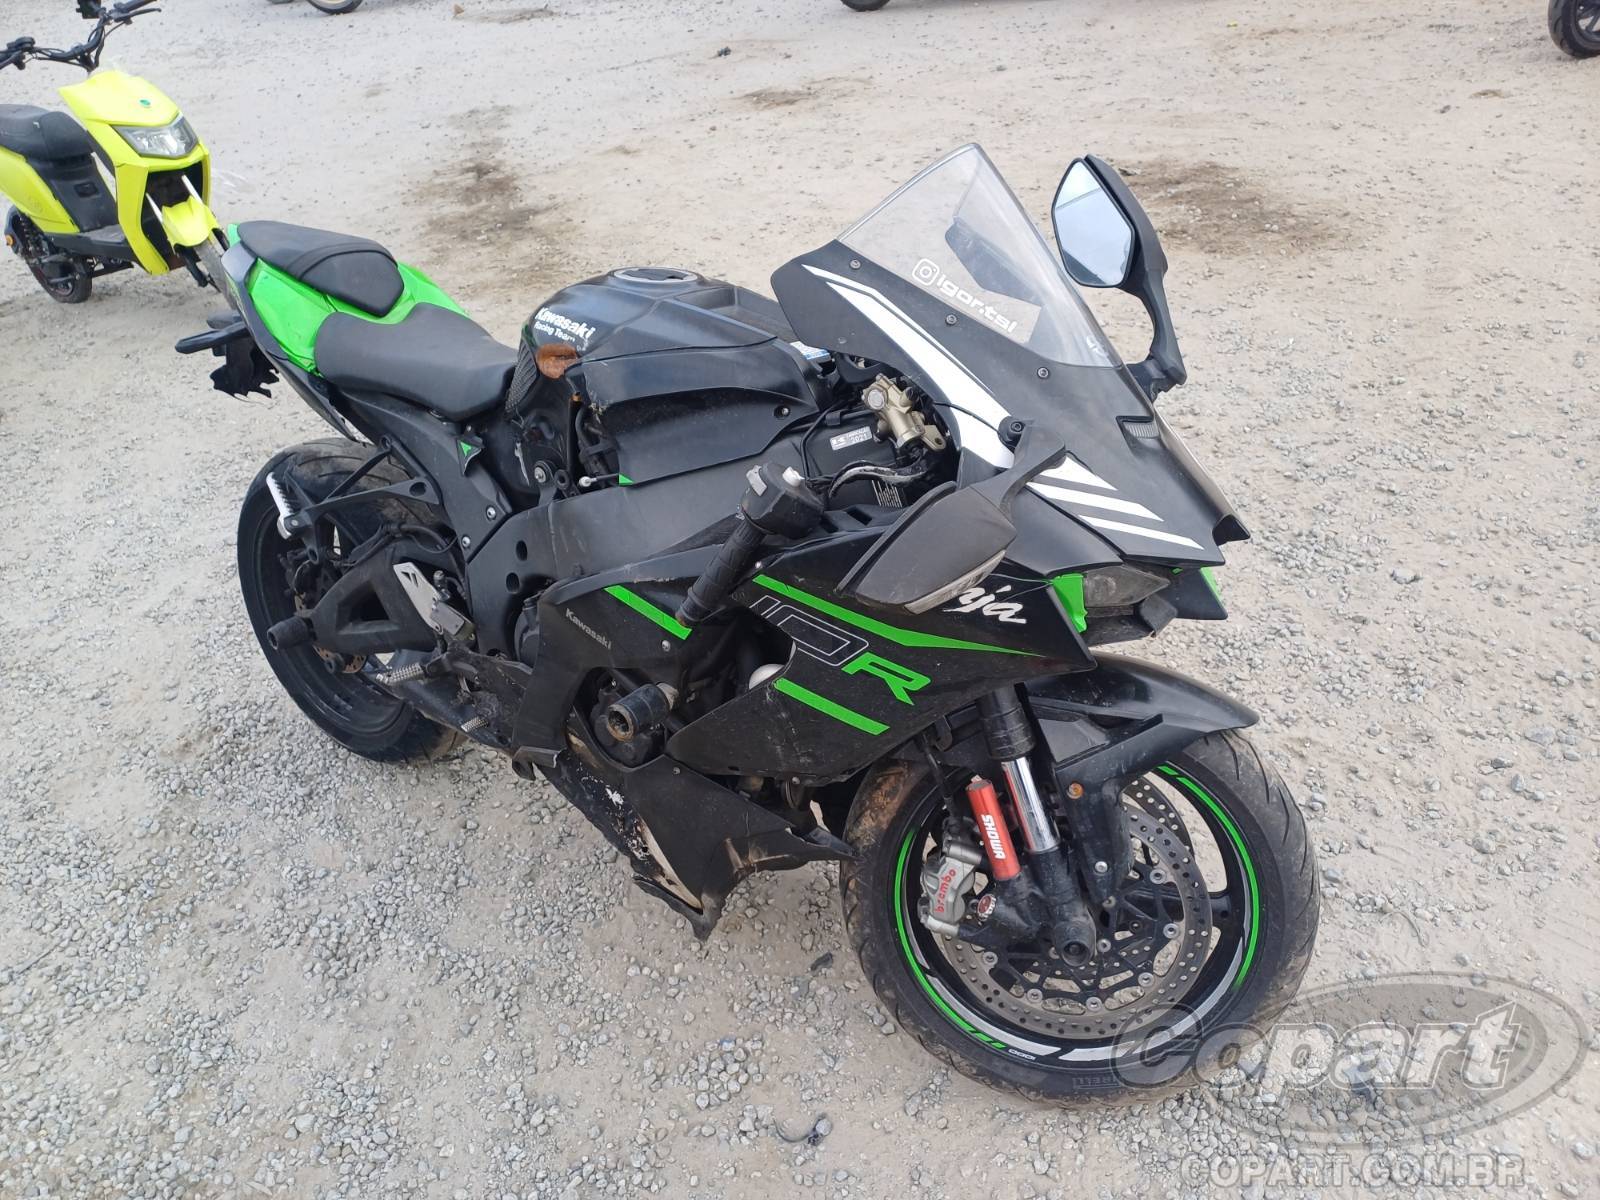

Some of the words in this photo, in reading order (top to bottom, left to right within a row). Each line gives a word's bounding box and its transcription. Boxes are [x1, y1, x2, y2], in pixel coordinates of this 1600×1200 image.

[534, 306, 596, 339] Kawasaki
[565, 607, 612, 650] Kawasaki
[980, 814, 1007, 860] SHOWA
[934, 868, 957, 913] brembo
